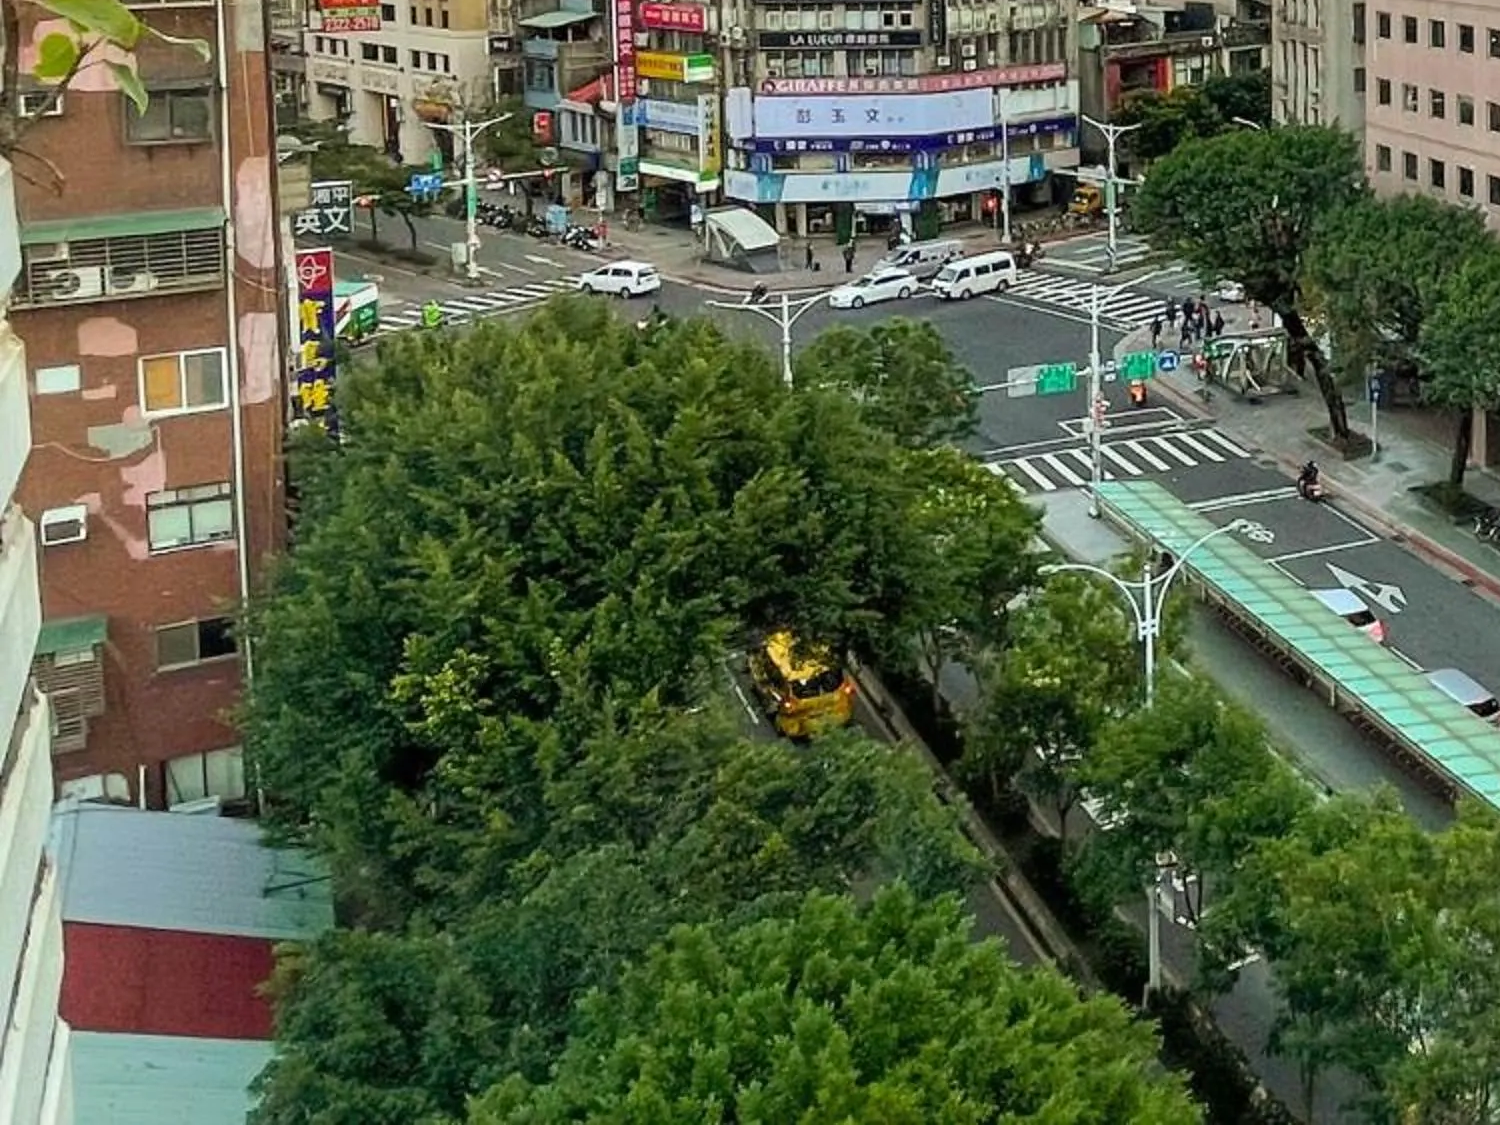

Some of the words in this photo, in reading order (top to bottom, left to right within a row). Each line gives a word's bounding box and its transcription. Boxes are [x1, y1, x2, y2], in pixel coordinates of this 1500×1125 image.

[790, 34, 805, 46] LA
[775, 79, 846, 93] GIRAFFE
[295, 206, 349, 235] 英文
